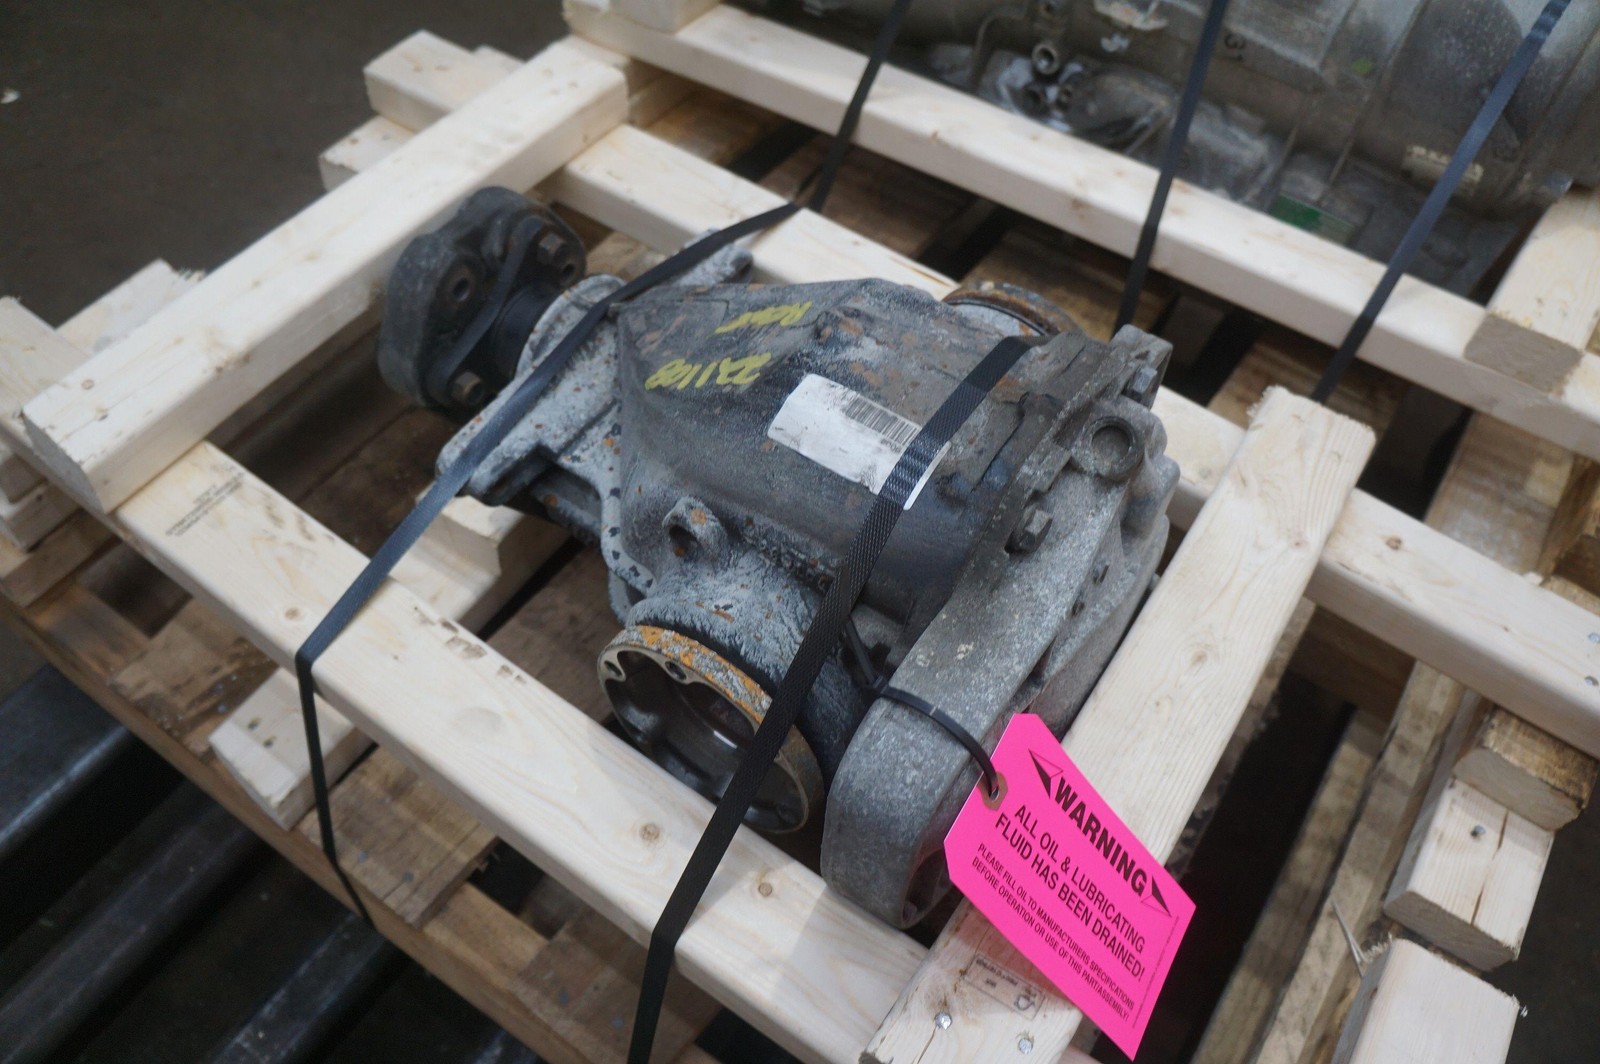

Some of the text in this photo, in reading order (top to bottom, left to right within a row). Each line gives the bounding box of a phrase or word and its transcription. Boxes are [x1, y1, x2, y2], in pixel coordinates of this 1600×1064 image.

[995, 812, 1146, 983] FLUID HAS BEEN DRAINED!
[1014, 804, 1146, 954] ALL OIL & LUBRICATING
[1055, 776, 1147, 897] WARNING
[971, 856, 1130, 1022] BEFORE OPERATION OR USE OF THIS PART/ASSEMBLY!
[977, 842, 1135, 1011] PLEASE FILL OIL TO MANUFACTURERS SPECIFICATIONS
